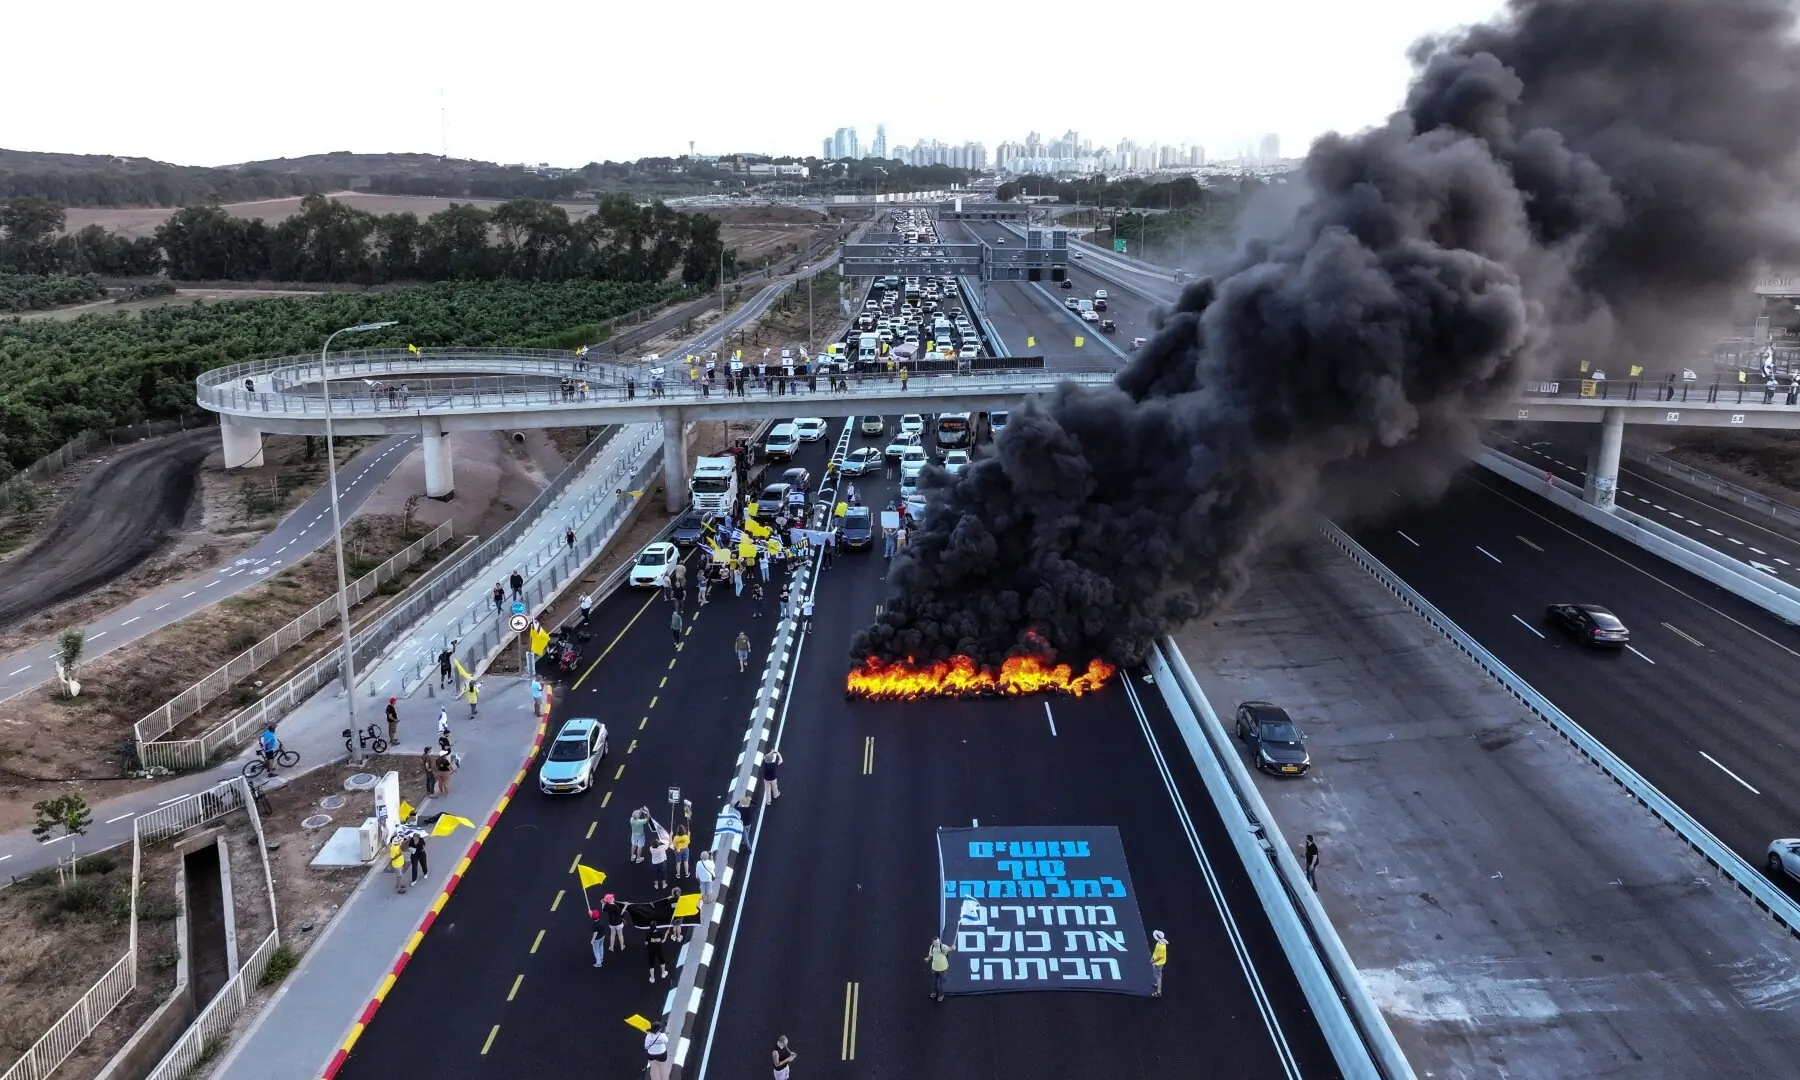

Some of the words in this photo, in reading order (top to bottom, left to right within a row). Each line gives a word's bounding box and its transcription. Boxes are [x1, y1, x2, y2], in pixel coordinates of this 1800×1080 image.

[969, 841, 1090, 857] עושים
[997, 860, 1066, 880] סוף
[957, 926, 1052, 951] כולם
[1063, 931, 1128, 951] את
[970, 957, 1122, 980] הביתה!
